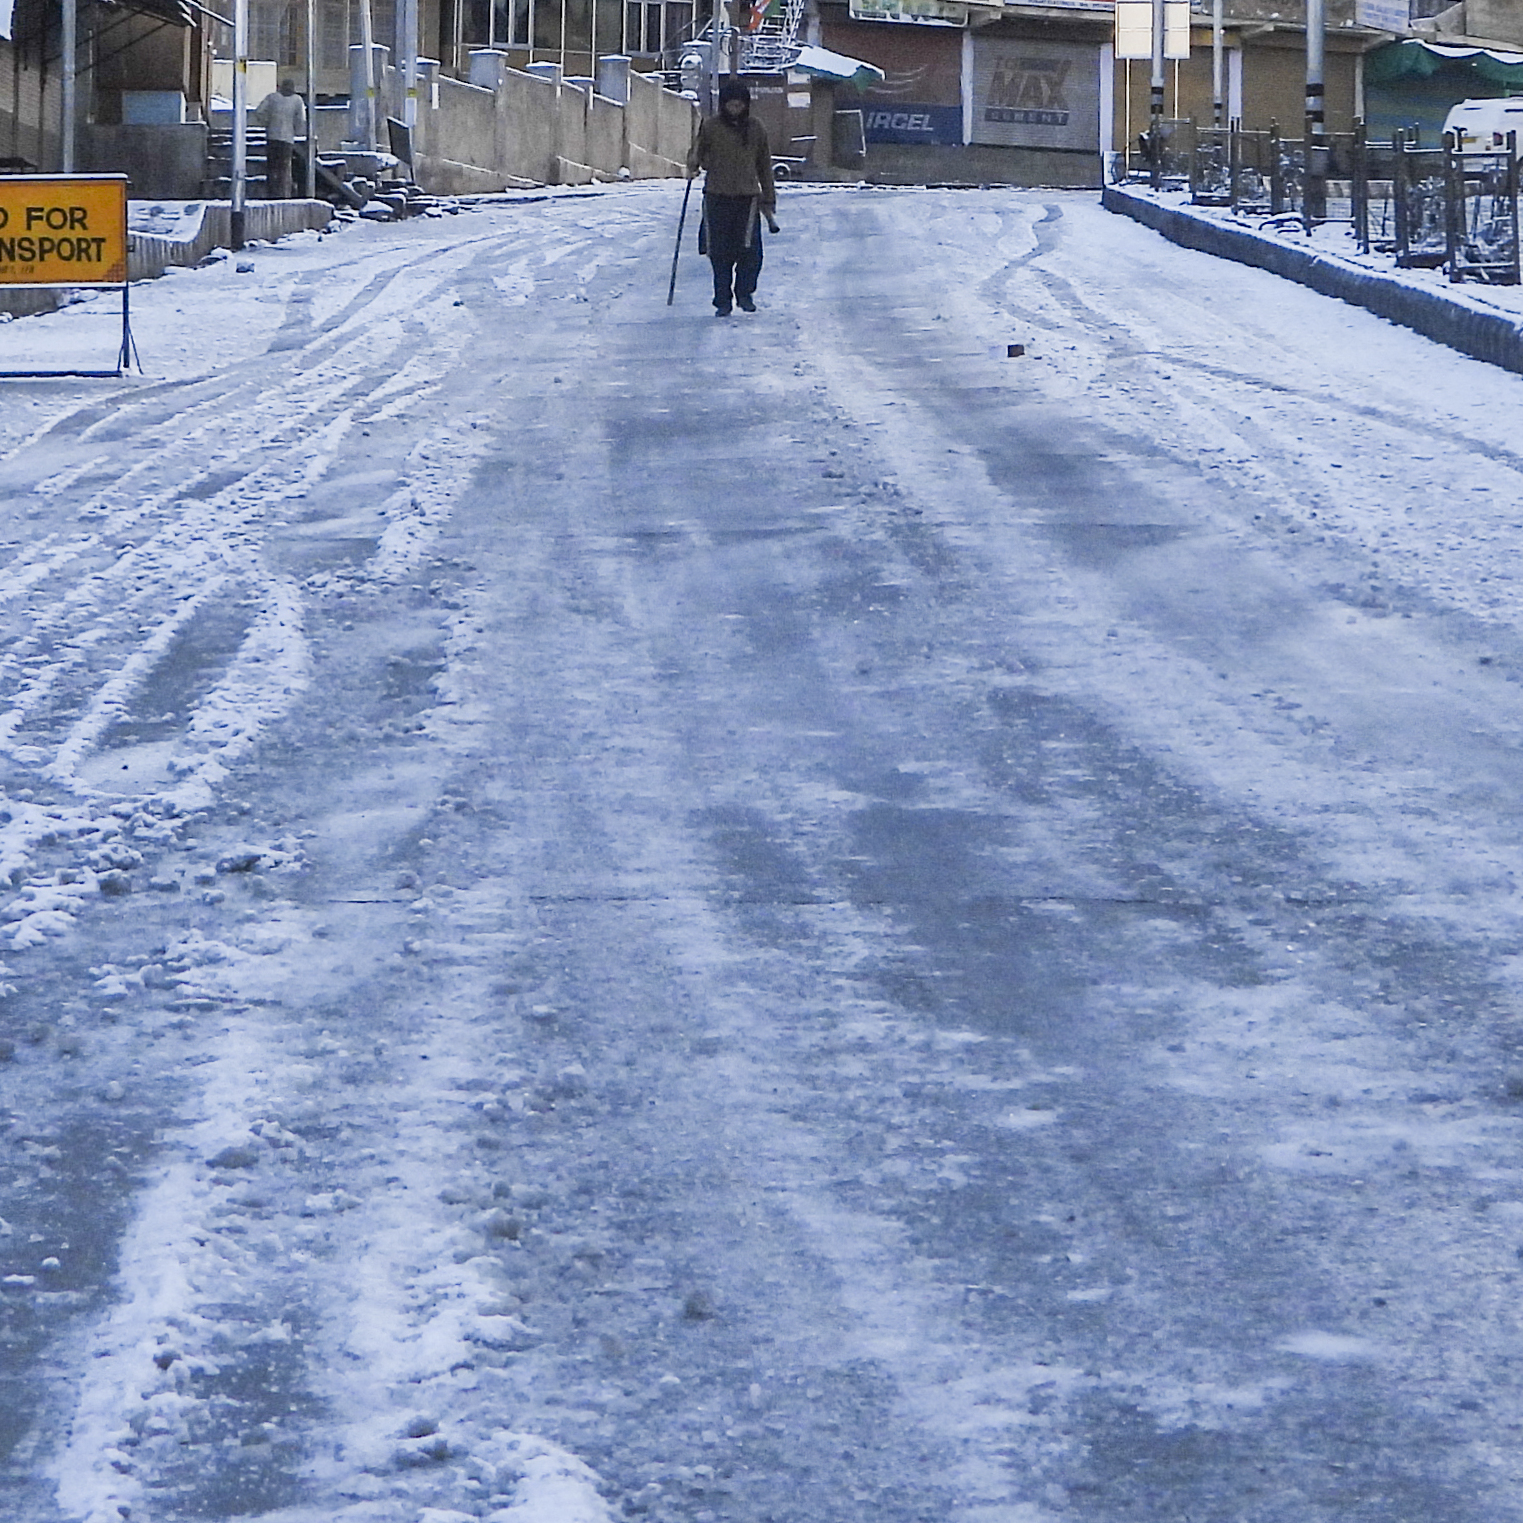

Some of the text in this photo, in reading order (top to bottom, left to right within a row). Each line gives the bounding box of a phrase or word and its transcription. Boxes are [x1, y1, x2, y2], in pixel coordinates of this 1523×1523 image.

[986, 60, 1073, 110] MAX
[865, 111, 934, 131] IRCEL
[25, 206, 88, 231] FOR
